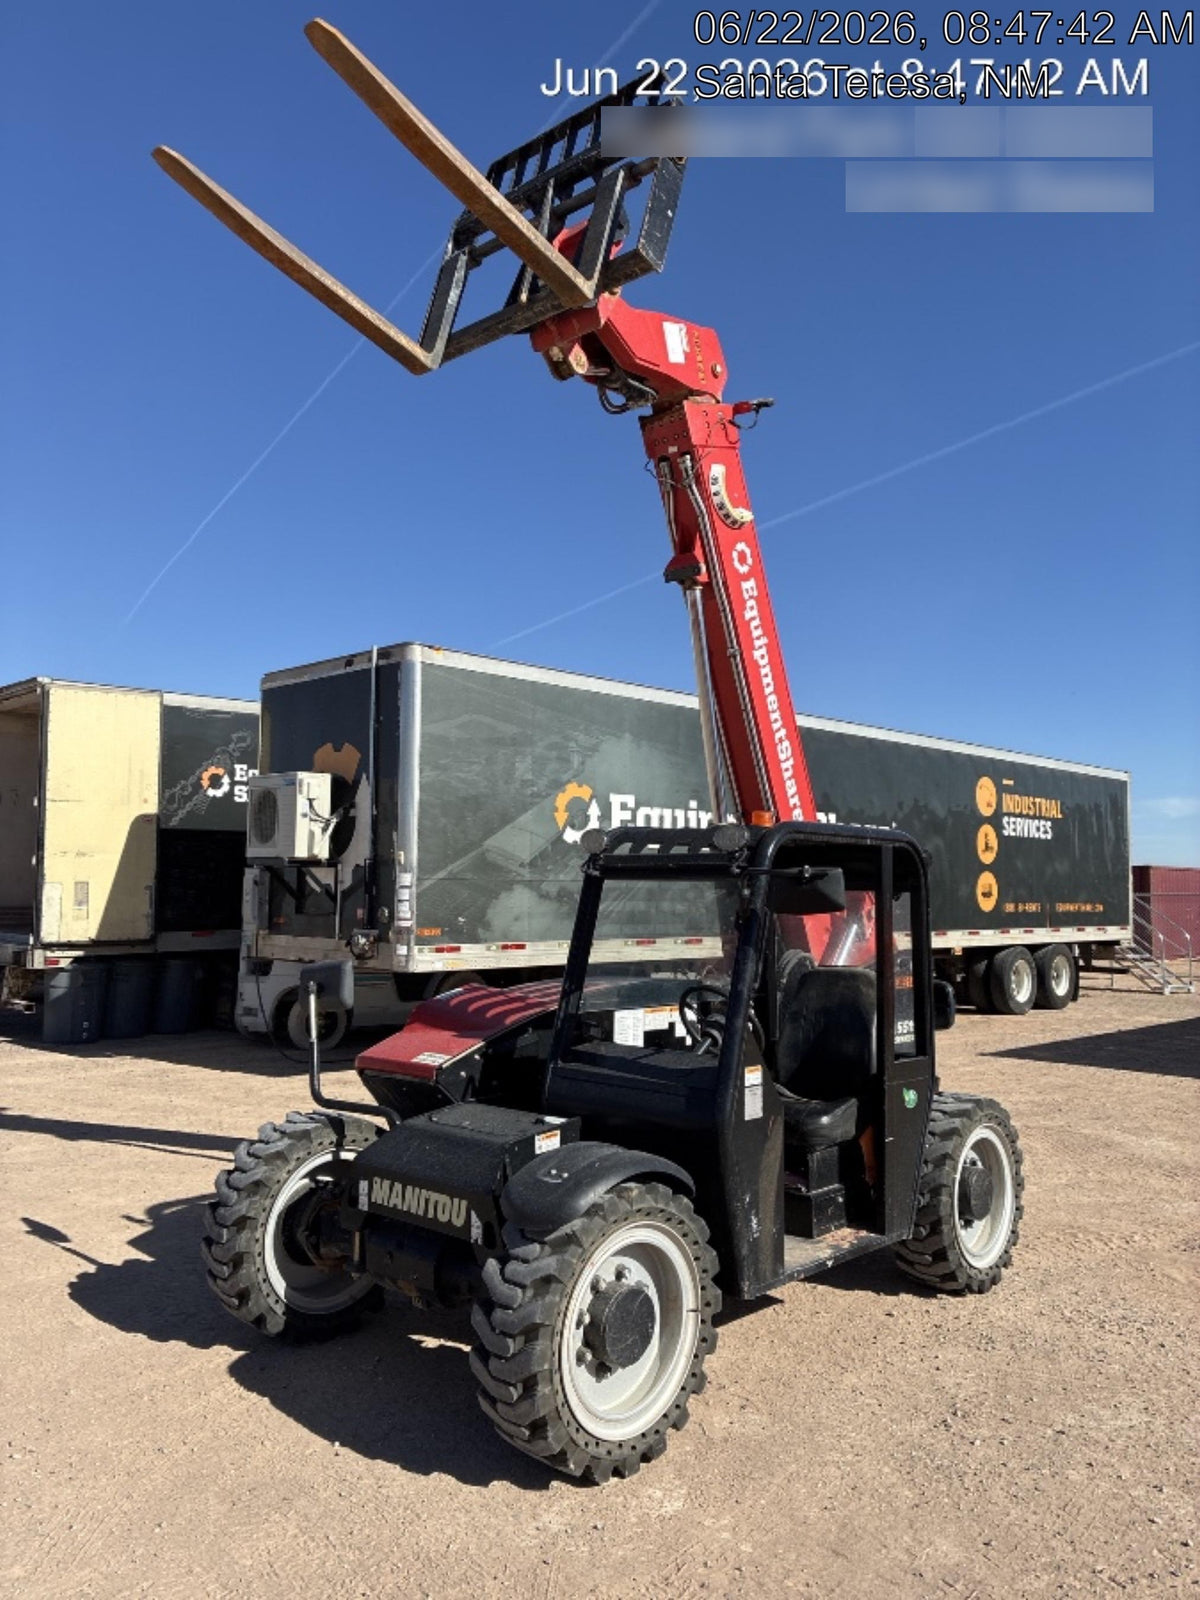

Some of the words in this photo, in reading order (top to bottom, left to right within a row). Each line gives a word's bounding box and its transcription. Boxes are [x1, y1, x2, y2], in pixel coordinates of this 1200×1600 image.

[740, 577, 804, 822] EquipmentShare
[1002, 792, 1063, 819] INDUSTRIAL
[1002, 815, 1053, 840] SERVICES
[371, 1176, 468, 1228] MANITOU
